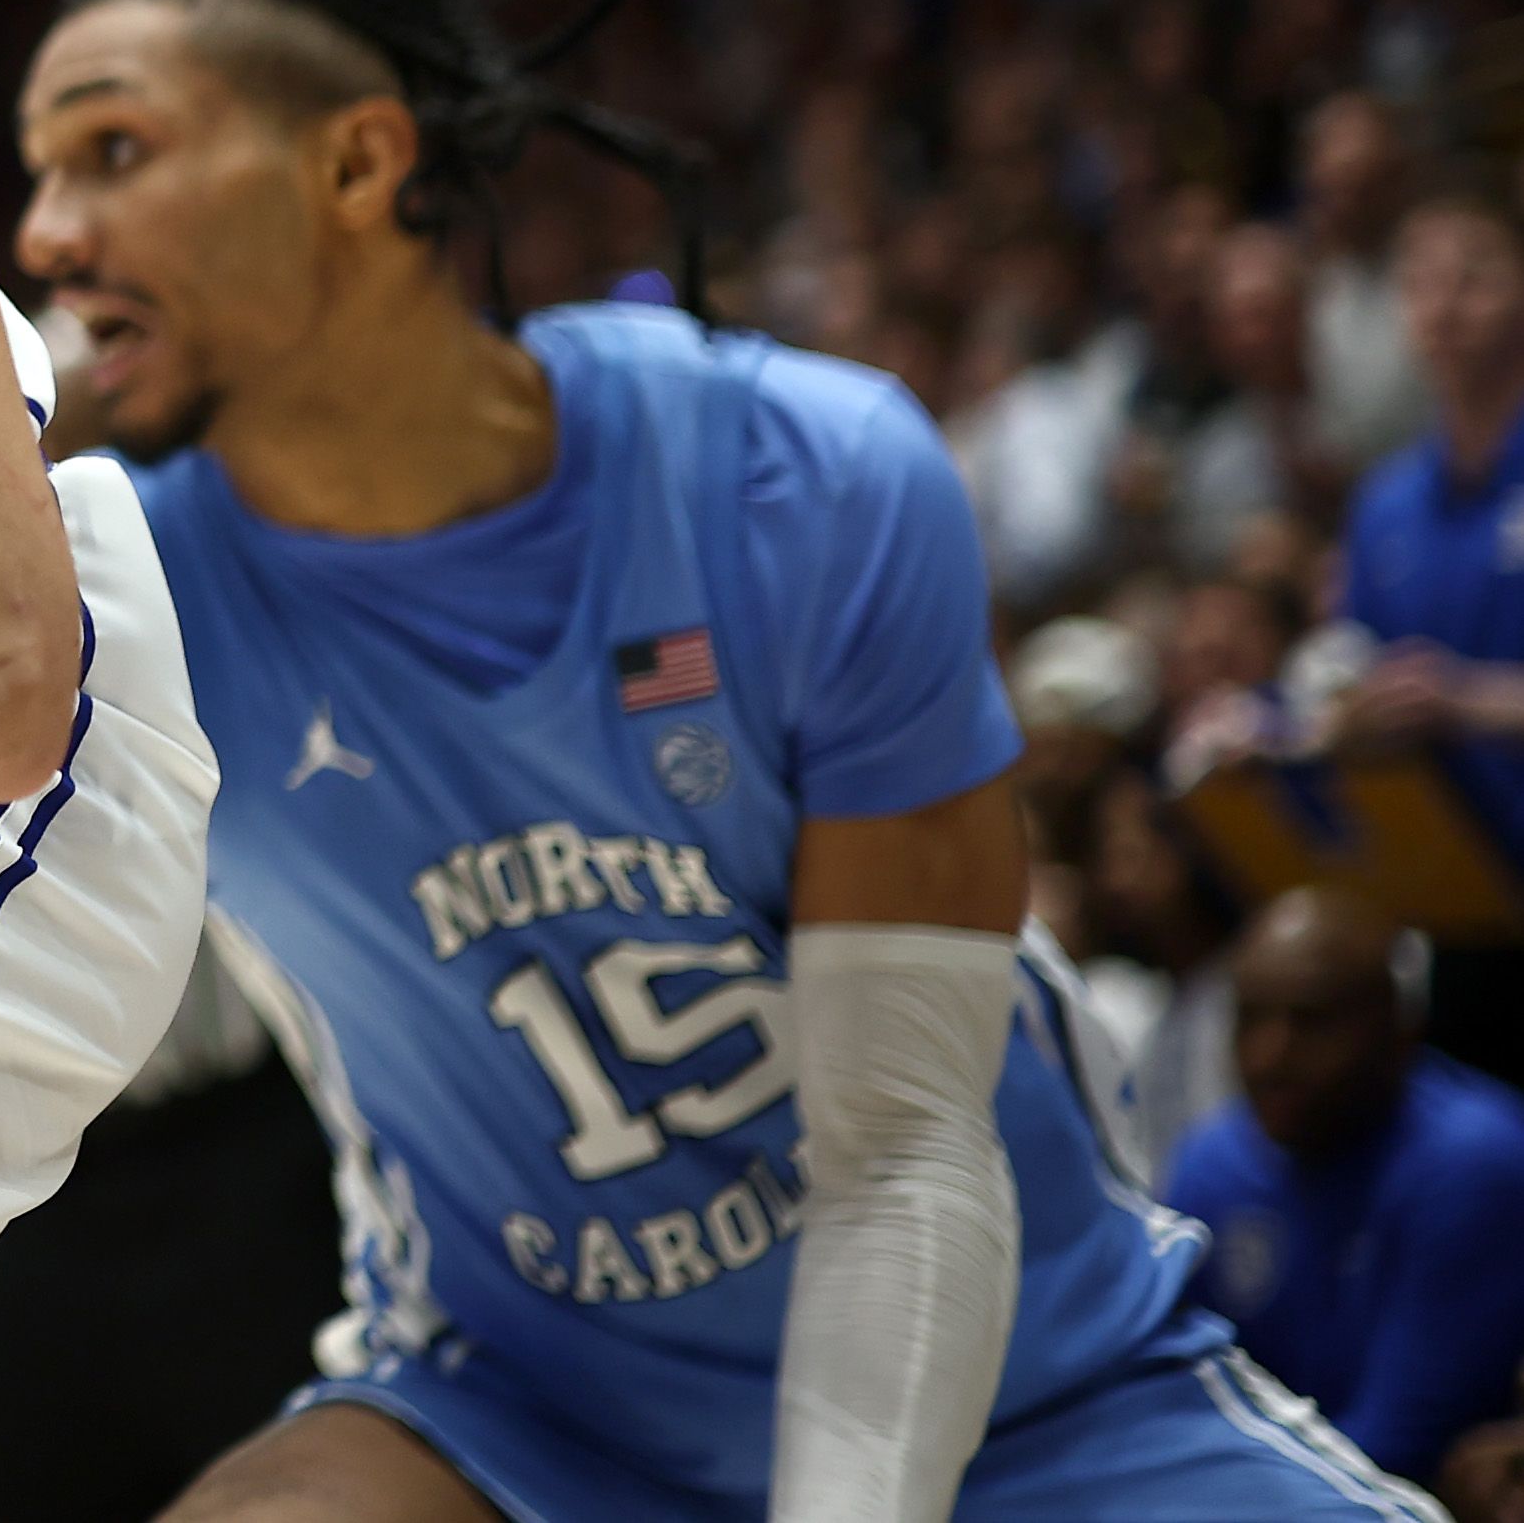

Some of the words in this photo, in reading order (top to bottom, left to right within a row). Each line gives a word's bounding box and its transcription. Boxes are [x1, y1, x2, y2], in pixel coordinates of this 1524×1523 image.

[410, 820, 735, 963] NORTH
[487, 936, 798, 1183] 15
[501, 1138, 810, 1305] CAROL
